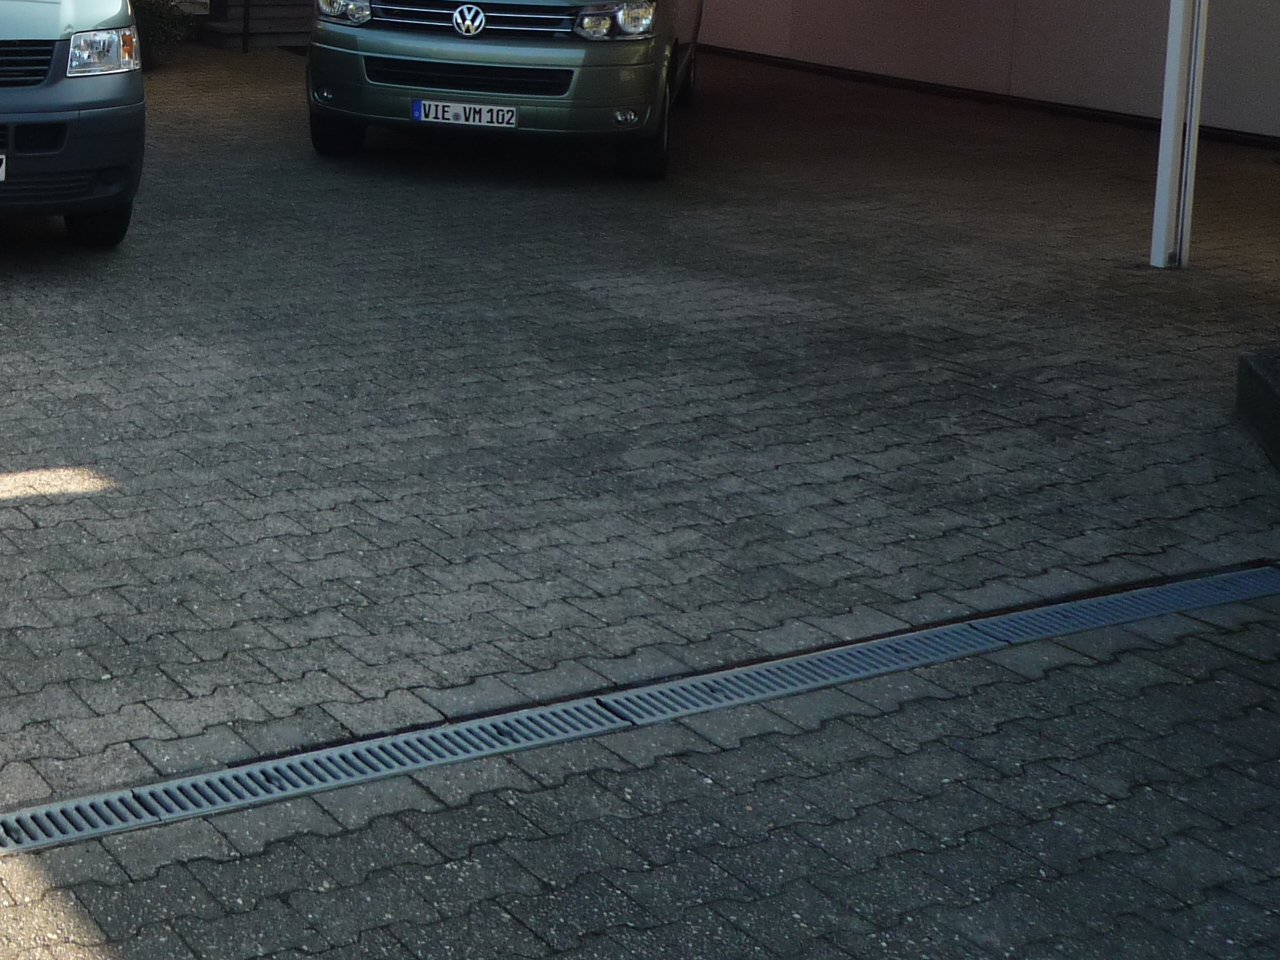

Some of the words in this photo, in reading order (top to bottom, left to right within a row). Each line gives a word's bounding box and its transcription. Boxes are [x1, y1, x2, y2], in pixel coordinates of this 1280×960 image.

[422, 103, 451, 121] VIE
[463, 106, 482, 123] VM
[486, 108, 515, 125] 102
